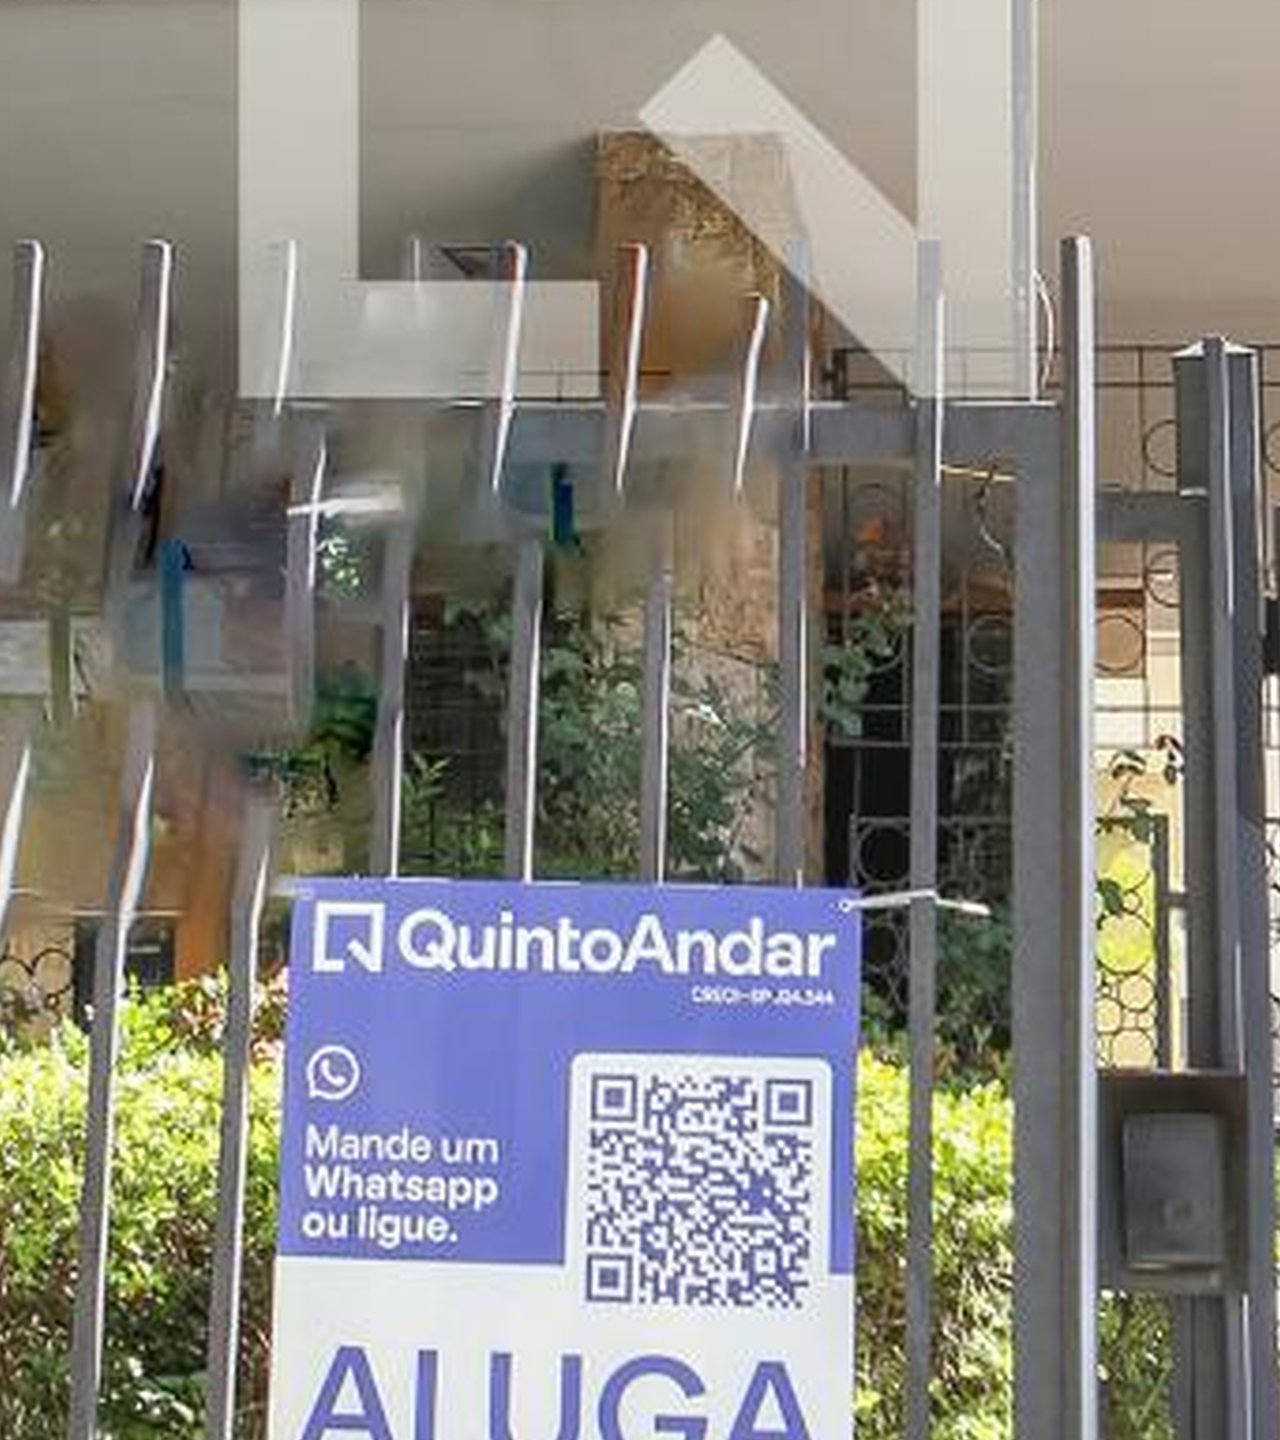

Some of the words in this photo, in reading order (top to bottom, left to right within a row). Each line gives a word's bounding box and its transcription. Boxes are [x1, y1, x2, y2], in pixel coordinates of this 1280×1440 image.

[397, 908, 837, 977] QuintoAndar
[305, 1124, 432, 1162] Mande
[441, 1138, 499, 1164] um
[303, 1164, 499, 1211] Whatsapp
[302, 1211, 348, 1238] ou
[358, 1205, 458, 1249] ligue.
